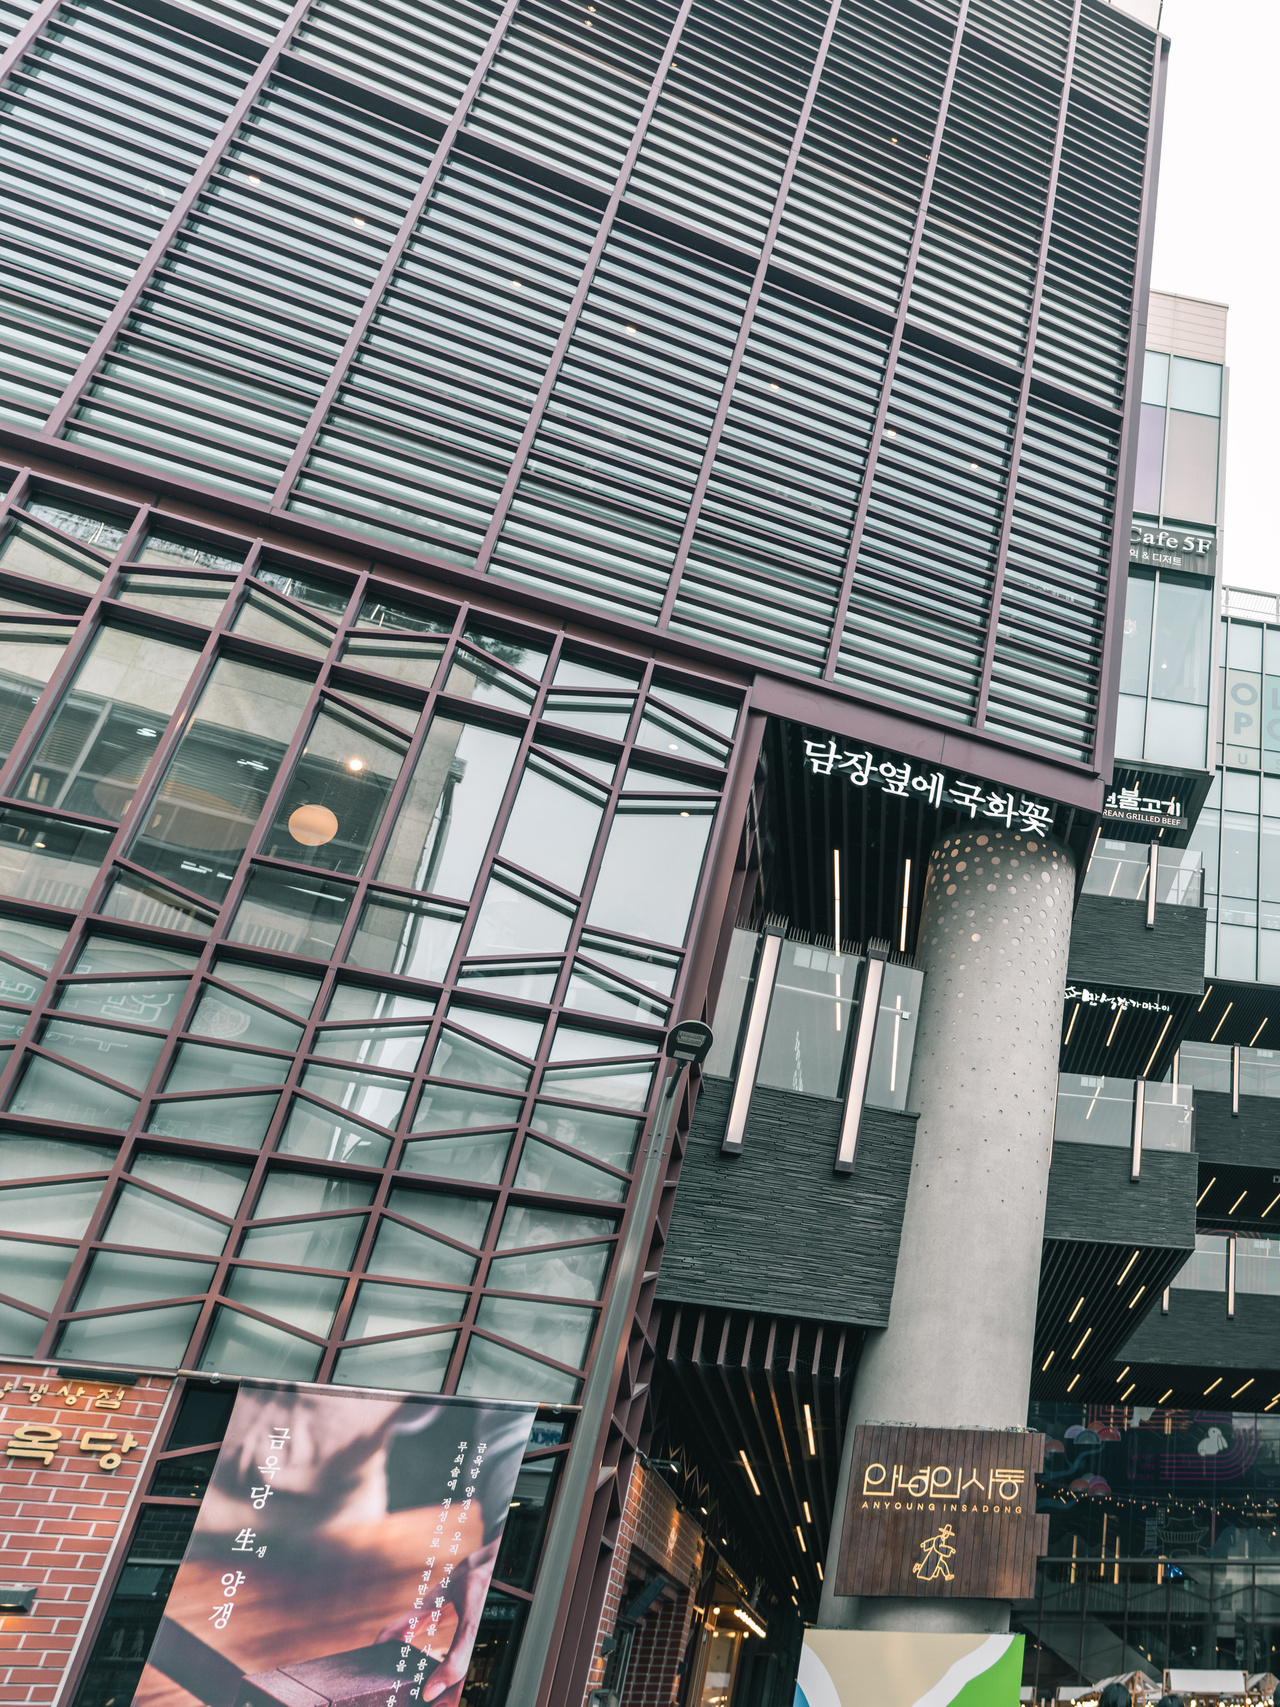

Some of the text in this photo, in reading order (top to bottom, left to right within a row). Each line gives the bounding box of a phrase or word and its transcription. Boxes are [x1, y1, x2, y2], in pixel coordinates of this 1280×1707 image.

[1130, 526, 1212, 555] Cafe 5F
[1152, 553, 1182, 566] 디저트
[803, 739, 1054, 838] 담장옆에국화꽃
[1126, 812, 1161, 823] GRILLED
[1161, 817, 1181, 826] BEEF
[6, 1425, 139, 1470] 옥당
[470, 1442, 487, 1479] 금옥당
[251, 1427, 291, 1509] 금옥당
[862, 1462, 1026, 1501] 안녕인사동
[861, 1501, 1022, 1514] ANYOUNG INSADONG
[208, 1570, 246, 1630] 양갱
